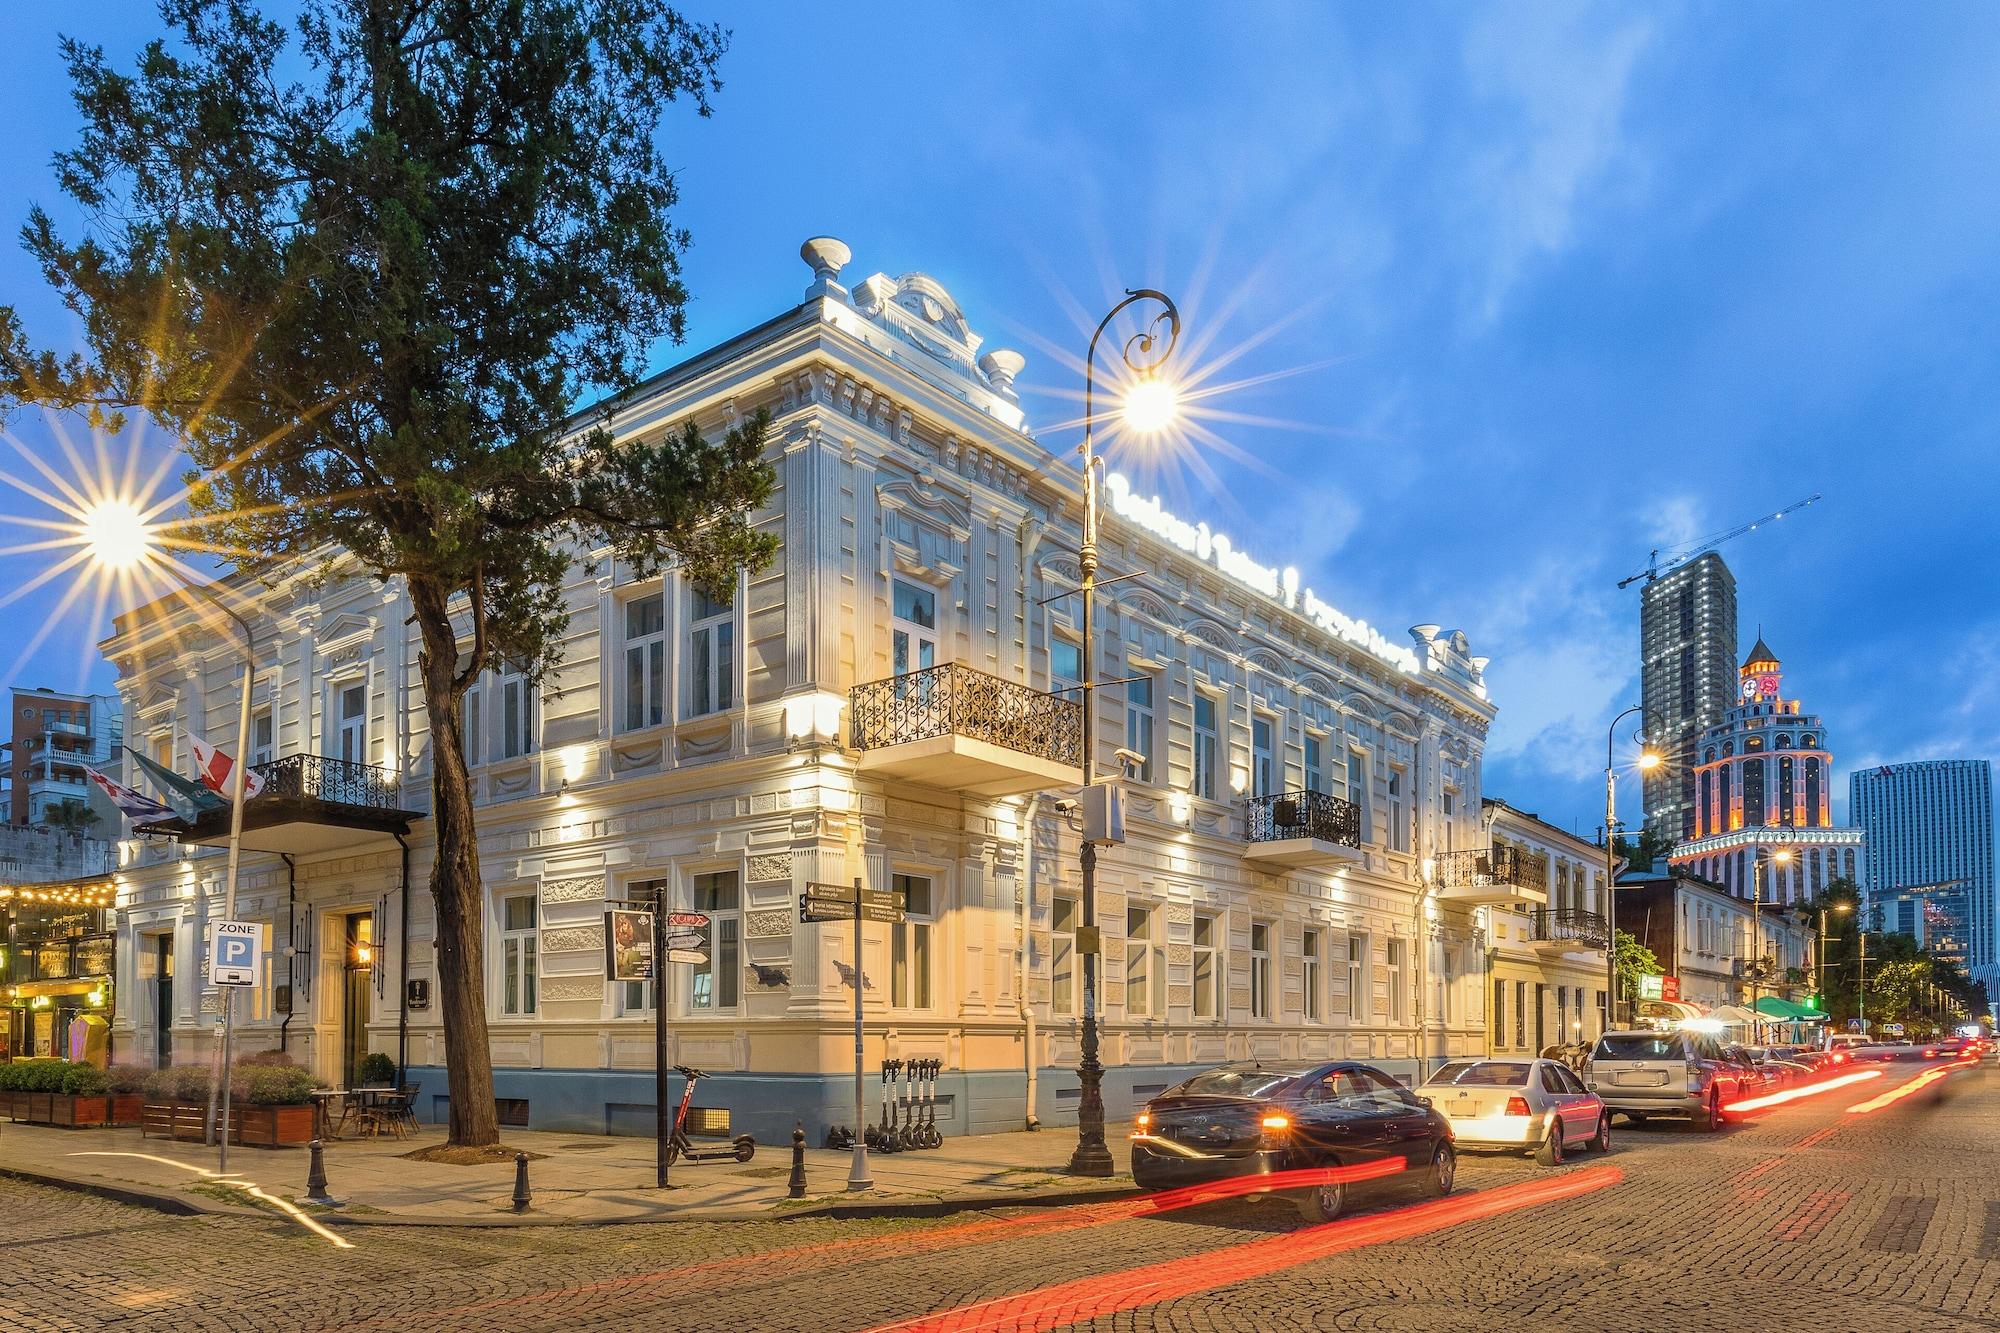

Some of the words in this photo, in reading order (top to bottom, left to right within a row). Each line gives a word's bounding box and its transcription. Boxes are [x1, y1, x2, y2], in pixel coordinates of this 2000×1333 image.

[1896, 760, 1967, 774] MARRIOTT
[218, 923, 256, 935] ZONE
[226, 940, 246, 962] P
